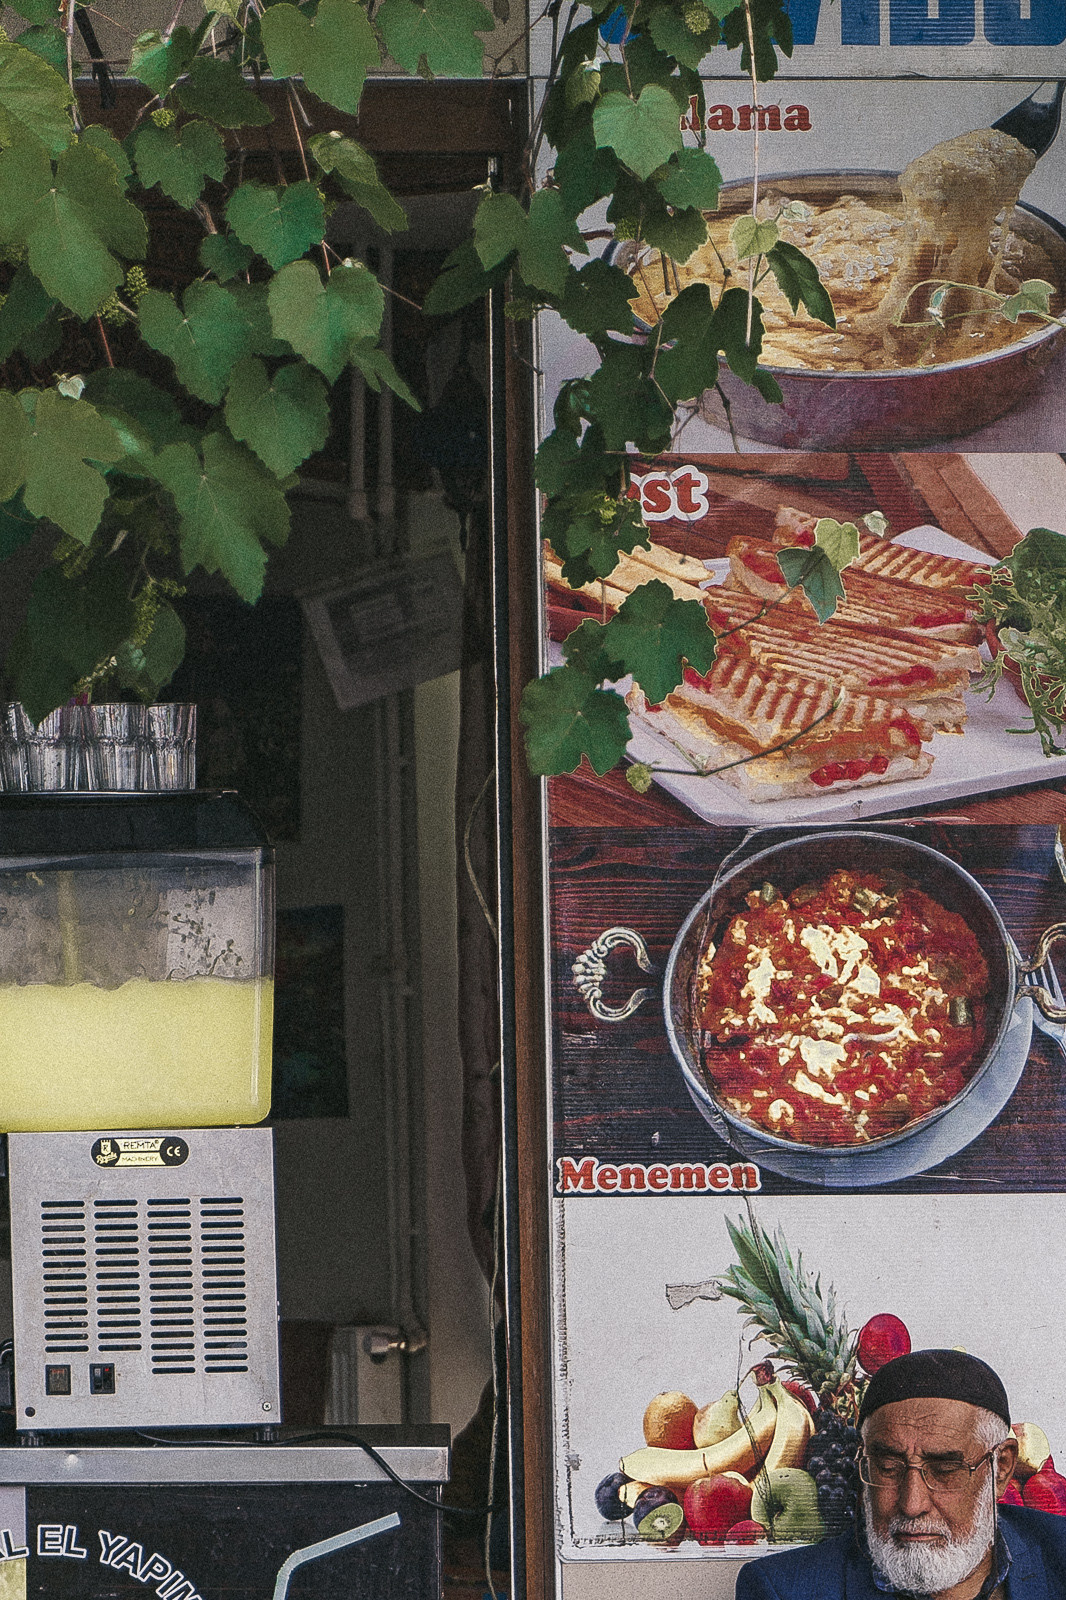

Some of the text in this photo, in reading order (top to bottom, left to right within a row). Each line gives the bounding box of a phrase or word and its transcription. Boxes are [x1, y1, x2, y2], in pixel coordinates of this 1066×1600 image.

[680, 95, 812, 131] lama
[558, 1158, 761, 1192] Menemen
[37, 1524, 87, 1559] EL
